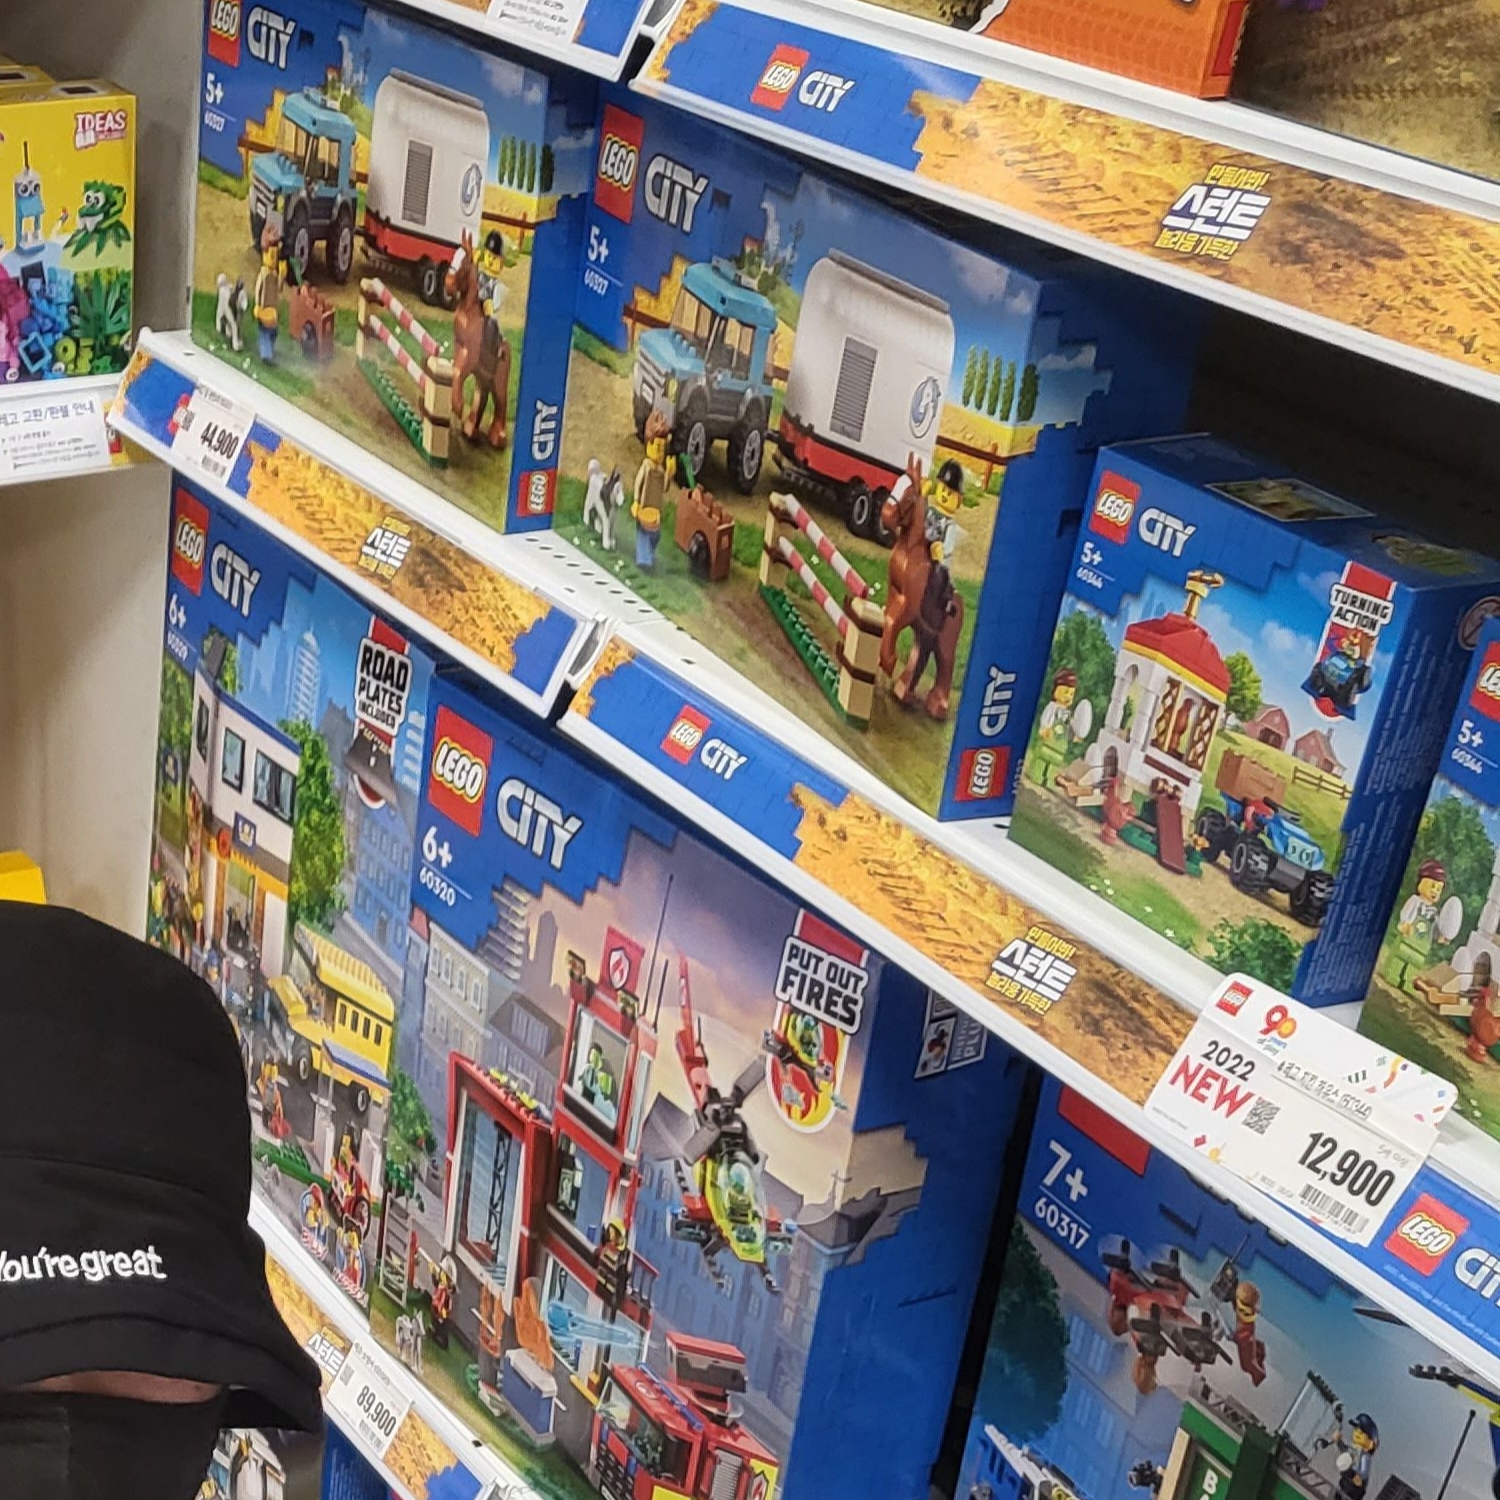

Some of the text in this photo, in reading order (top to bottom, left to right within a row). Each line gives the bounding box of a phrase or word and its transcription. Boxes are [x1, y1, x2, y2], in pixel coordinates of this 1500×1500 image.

[211, 0, 297, 69] LEGO CITY
[205, 72, 225, 105] 5+
[761, 63, 856, 112] LEGO CITY
[75, 111, 127, 133] IDEAS
[601, 137, 710, 233] LEGO CITY
[1161, 184, 1273, 241] 스턴트
[586, 225, 611, 265] 5+
[526, 400, 560, 513] LEGO CITY
[1096, 492, 1198, 558] LEGO CITY
[175, 519, 261, 618] LEGO CITY
[1079, 541, 1103, 565] 5+
[168, 593, 187, 629] 6+
[1333, 588, 1390, 619] TURNING
[1333, 605, 1379, 632] ACTION
[357, 675, 405, 714] PLATES
[358, 645, 411, 693] ROAD
[356, 699, 397, 730] INCLUDED
[970, 665, 1017, 798] LEGO CITY
[1457, 719, 1484, 748] 5+
[671, 720, 750, 781] LEGO CITY
[433, 741, 584, 872] LEGO CITY
[421, 826, 454, 869] 6+
[418, 867, 457, 907] 60320
[787, 943, 864, 997] PUT OUT
[991, 938, 1078, 1002] 스턴트
[780, 965, 860, 1028] FIRES
[1168, 1054, 1257, 1120] NEW
[1200, 1040, 1257, 1084] 2022
[1041, 1138, 1089, 1204] 7+
[1298, 1130, 1398, 1208] 12,900
[1033, 1196, 1092, 1251] 60317
[1400, 1214, 1453, 1254] LEGO
[80, 1245, 167, 1282] great
[355, 1384, 398, 1439] 89,900
